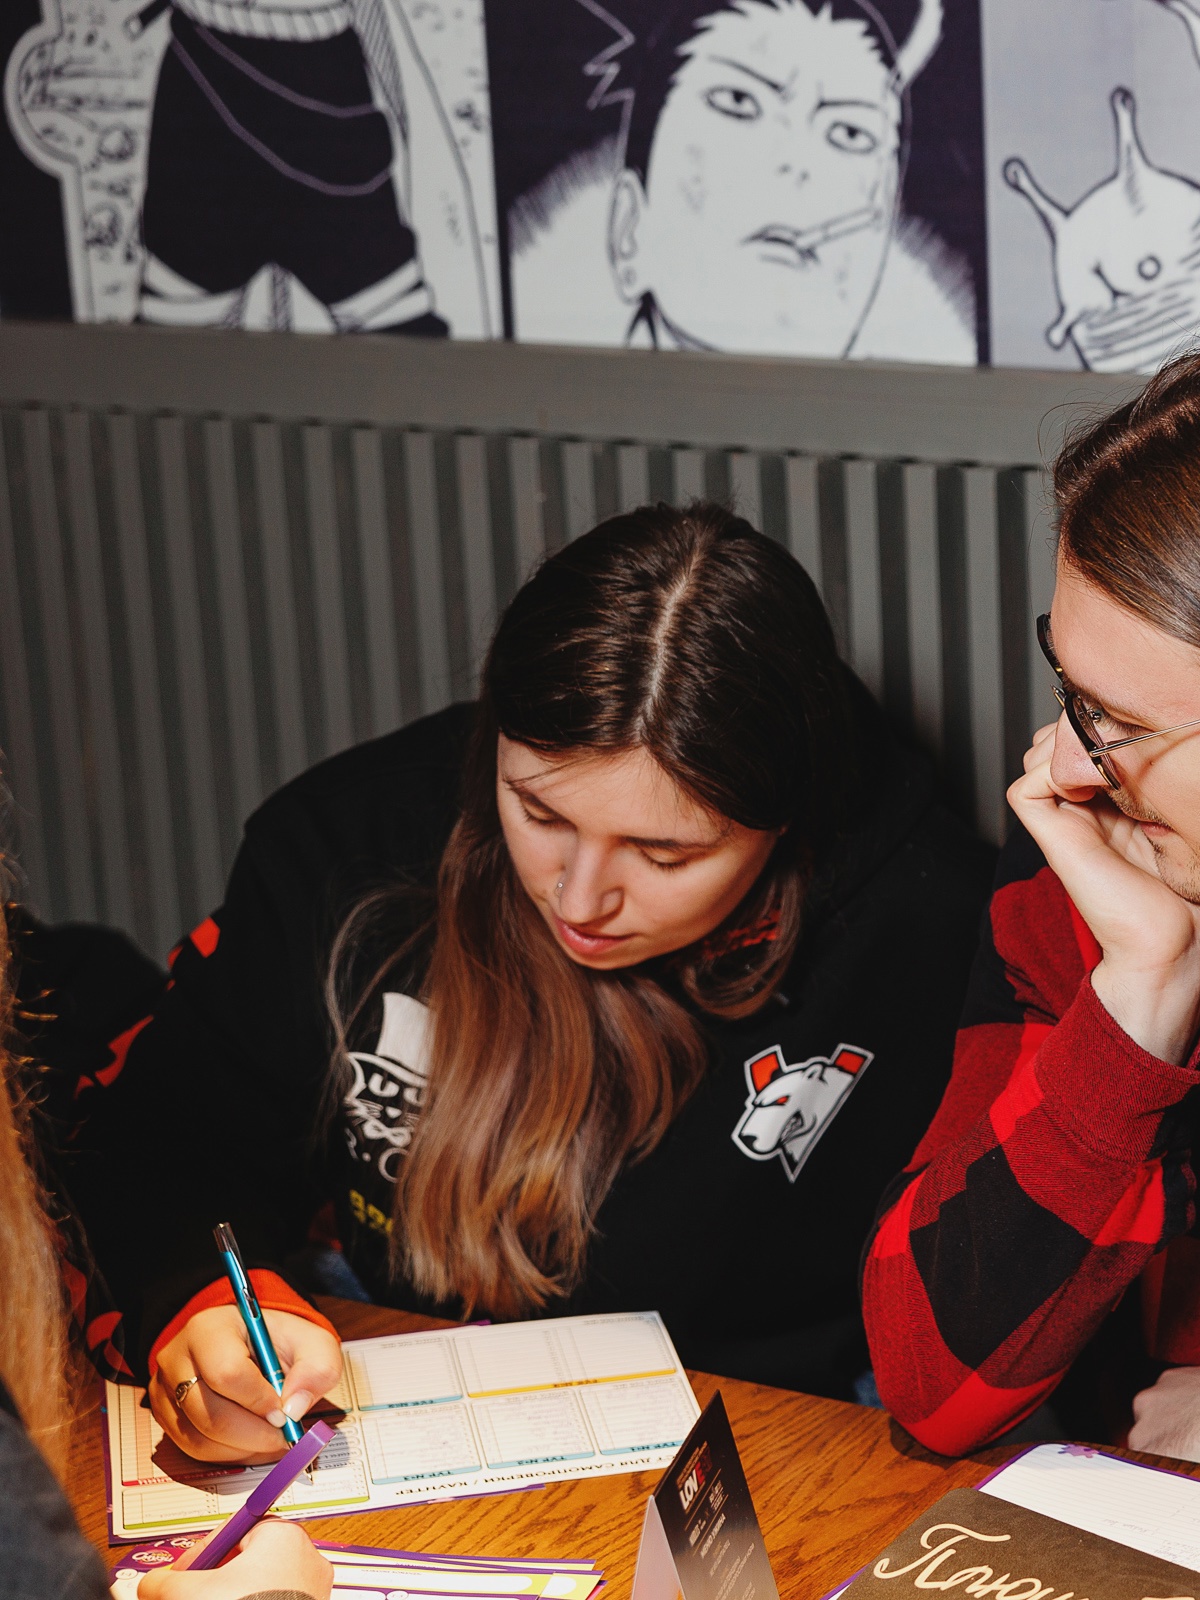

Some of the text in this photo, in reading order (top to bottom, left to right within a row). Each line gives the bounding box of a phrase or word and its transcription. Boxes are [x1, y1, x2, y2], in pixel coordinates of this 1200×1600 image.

[537, 1455, 565, 1463] ТУР
[427, 1469, 453, 1477] ТУР
[482, 1462, 615, 1484] САМОПРОВЕРКИ
[395, 1480, 468, 1496] КАУНТЕР
